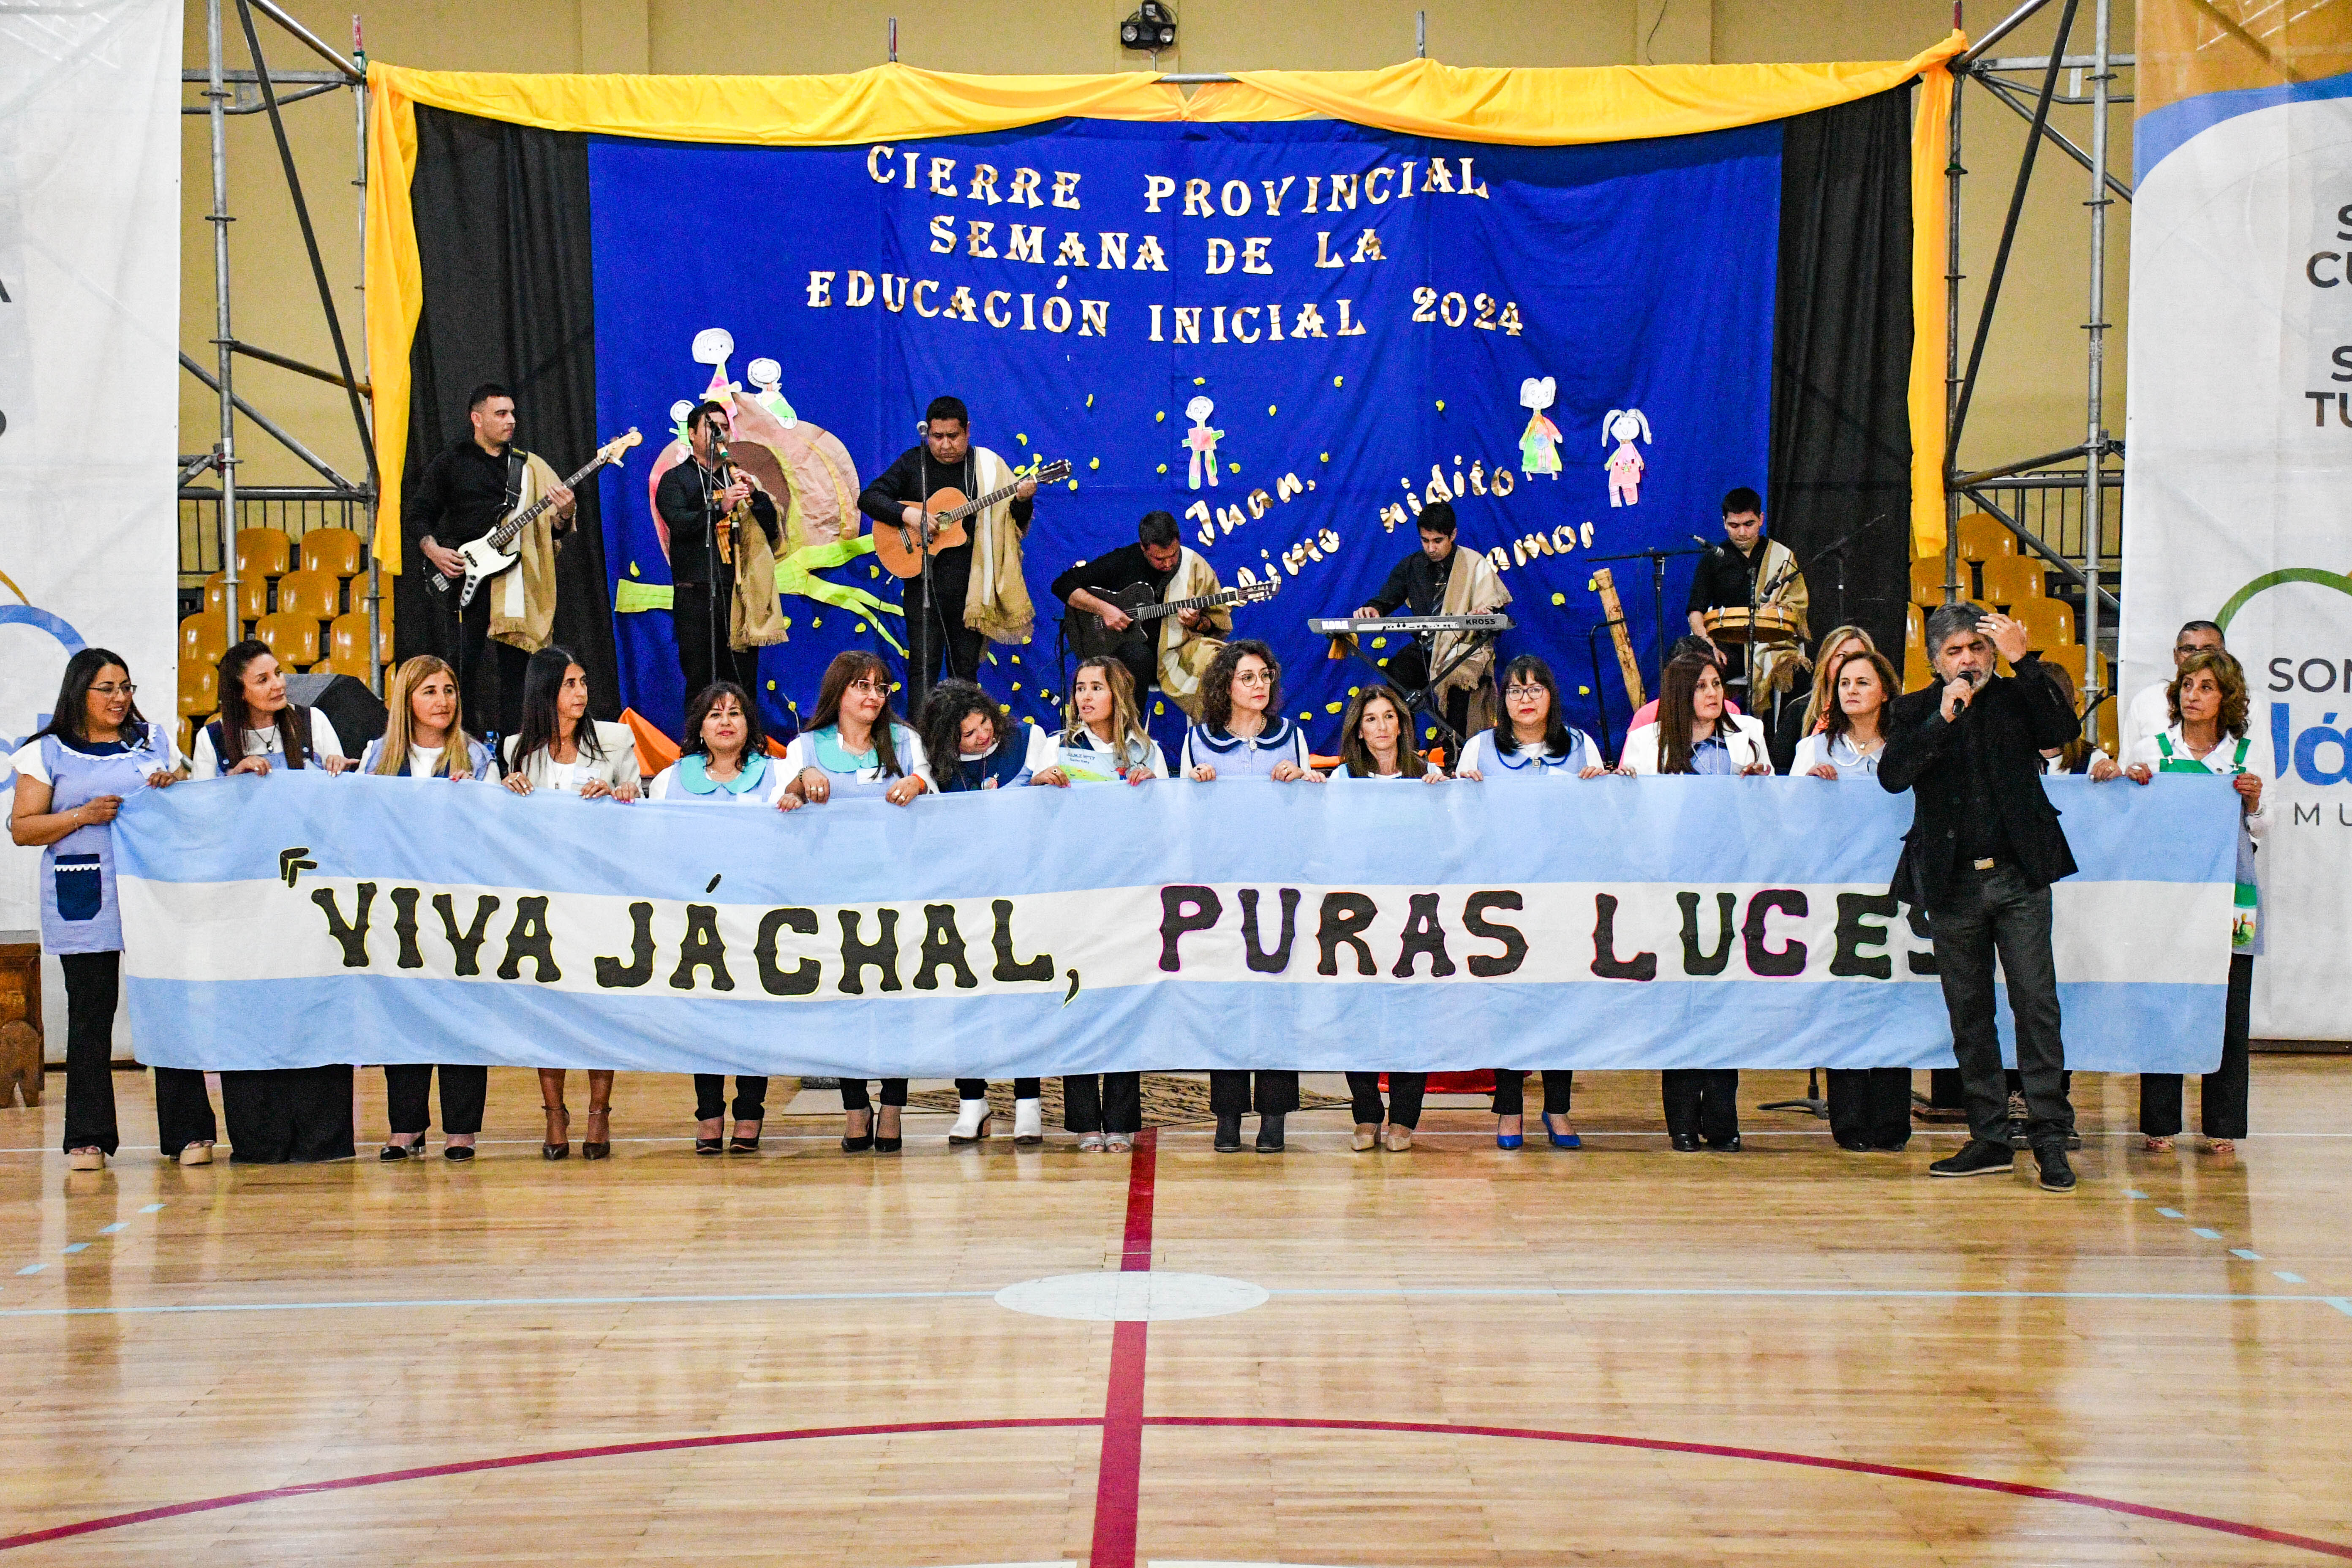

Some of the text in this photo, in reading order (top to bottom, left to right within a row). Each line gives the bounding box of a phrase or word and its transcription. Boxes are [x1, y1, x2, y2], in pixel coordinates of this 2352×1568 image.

[867, 144, 1489, 218] CIERRE PROVINCIAL
[930, 215, 1387, 275] SEMANA DE LA
[806, 270, 1523, 344] EDUCACIÓN INICIAL 2024
[1486, 521, 1594, 573] amor
[1321, 620, 1349, 630] KORG
[2268, 657, 2352, 693] SO
[1158, 885, 1529, 978] PURAS
